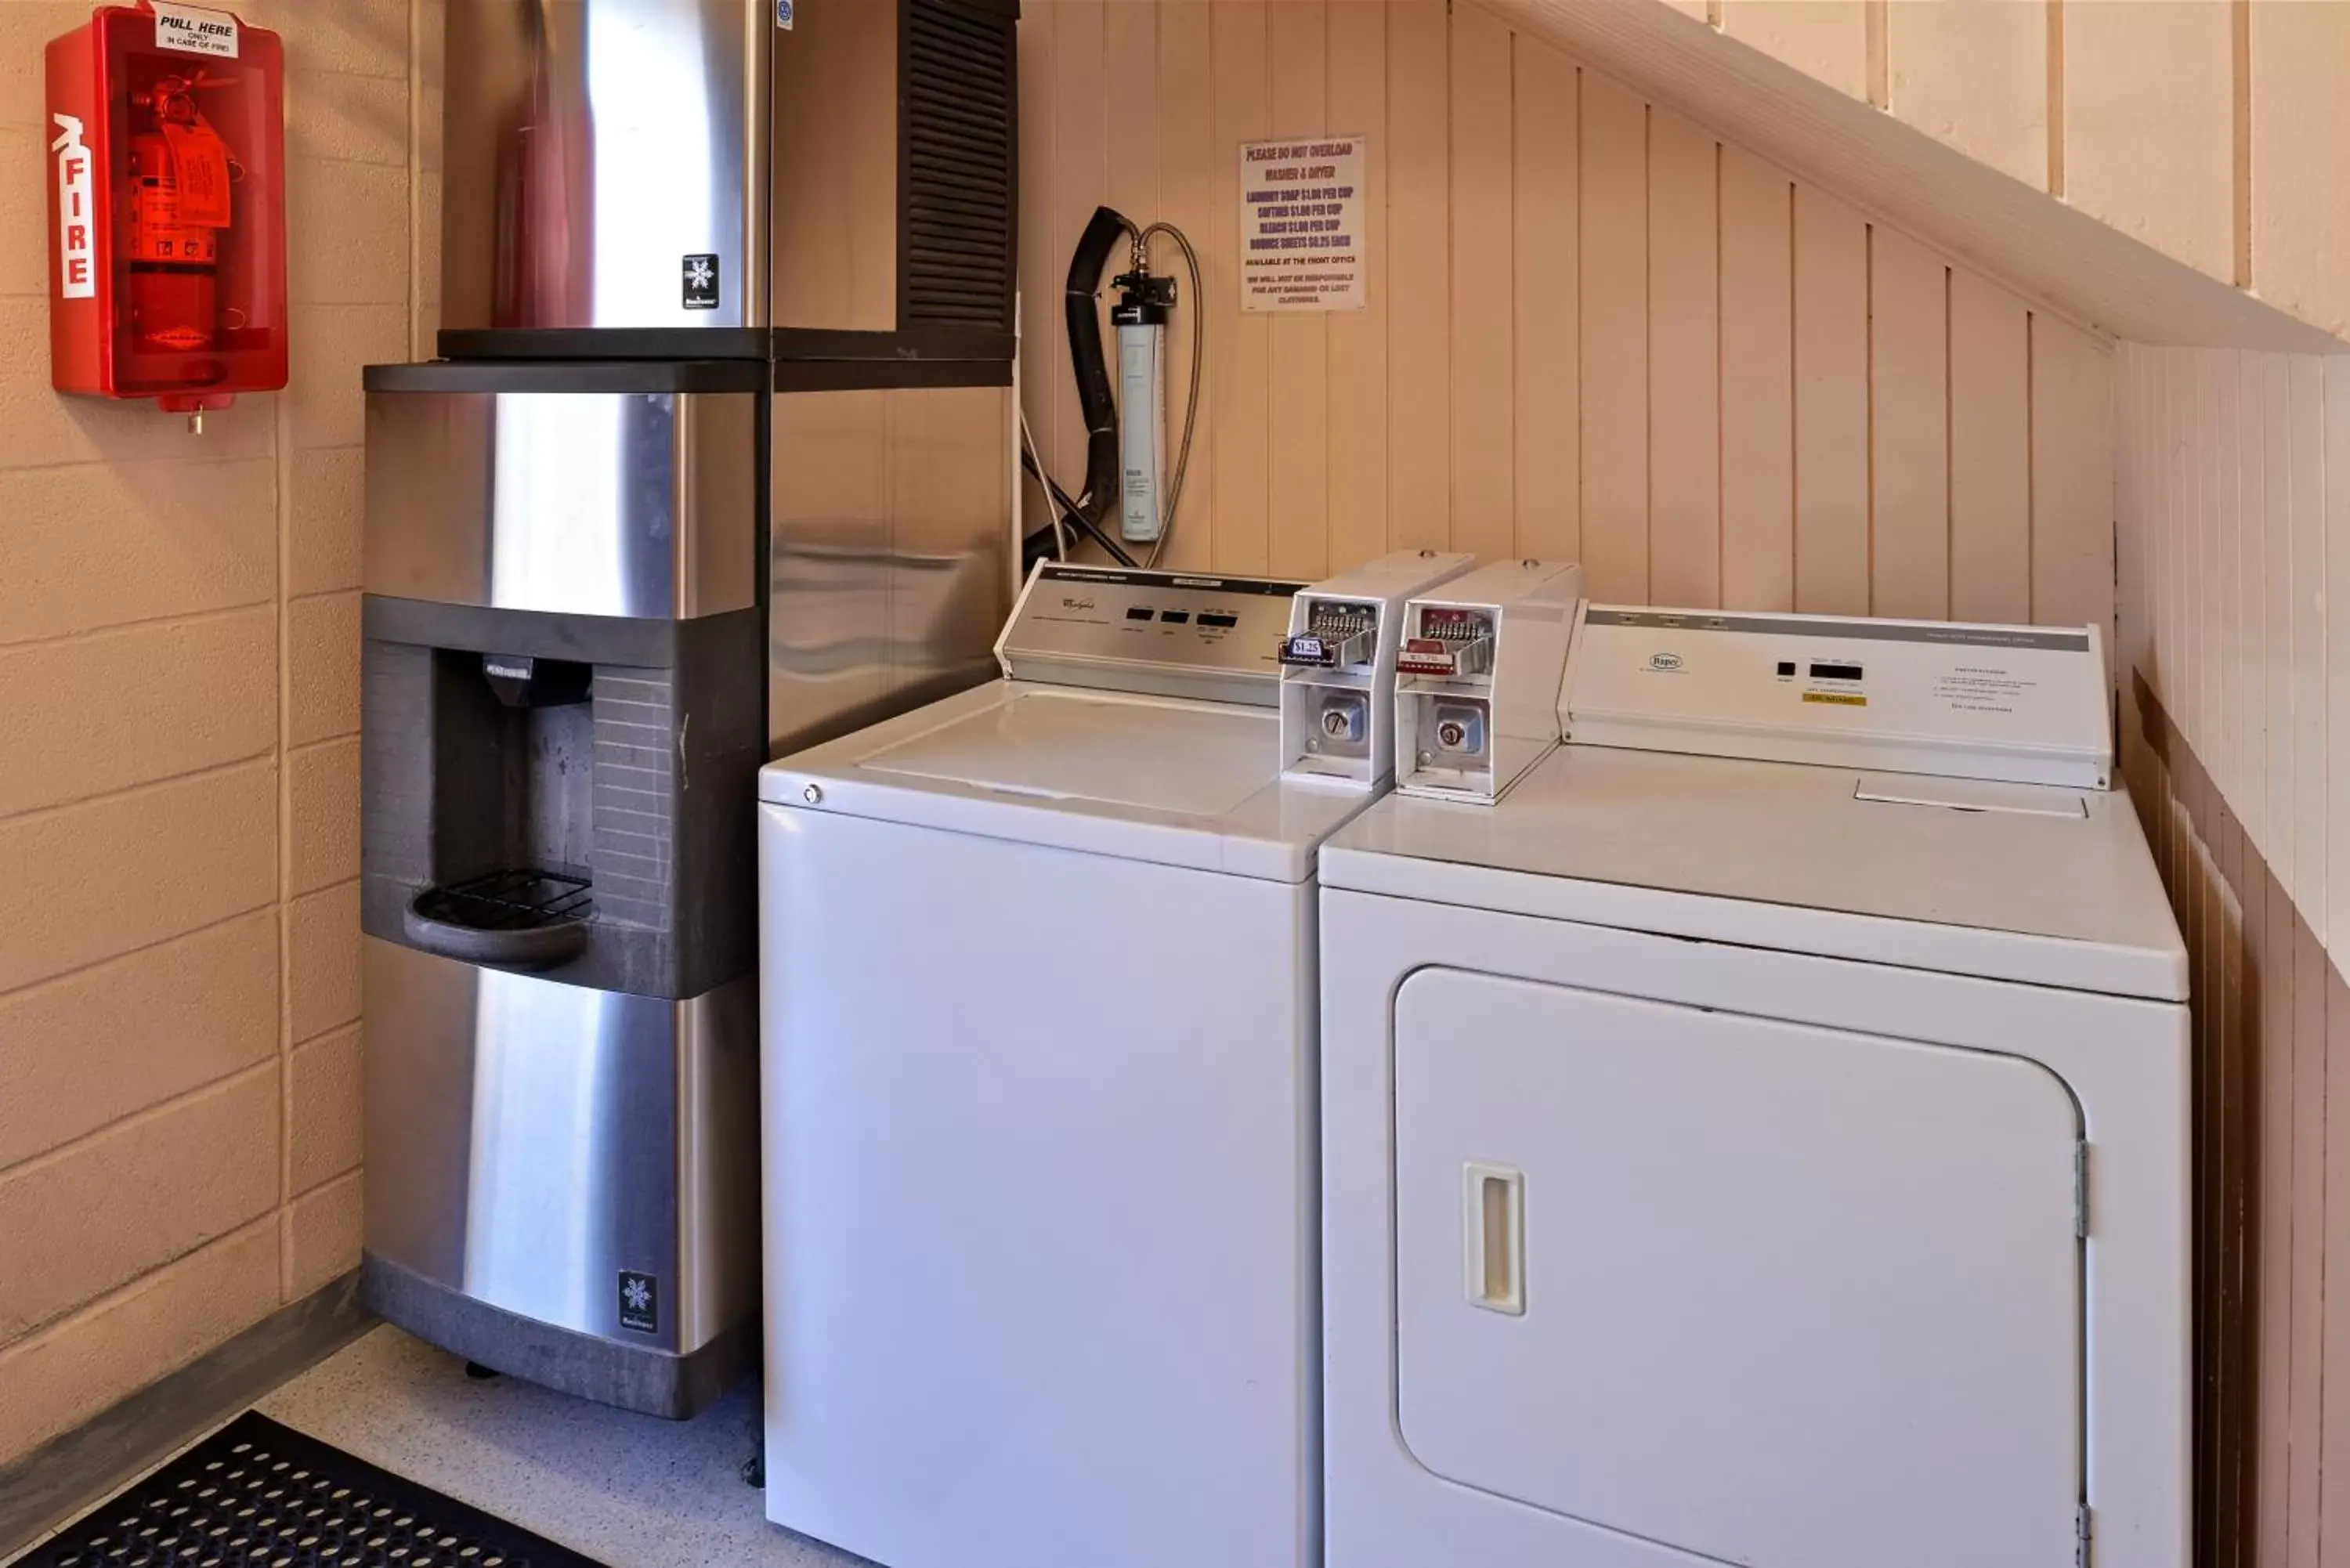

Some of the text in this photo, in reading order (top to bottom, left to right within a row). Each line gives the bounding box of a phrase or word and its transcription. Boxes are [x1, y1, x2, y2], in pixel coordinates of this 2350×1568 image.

[161, 16, 233, 37] PULL HERE
[188, 32, 208, 41] ONLY
[177, 38, 196, 47] CASE
[1246, 143, 1353, 161] PLEASE DO NOT OVERLOAD
[1266, 168, 1298, 182] WASHER
[1308, 165, 1336, 179] DRYER
[1247, 190, 1278, 203] LAUNDRY
[1281, 189, 1300, 201] SOAP
[1322, 187, 1336, 199] PER
[1338, 186, 1354, 198] CUP
[1312, 204, 1325, 215] PER
[1327, 204, 1343, 215] CUP
[66, 158, 87, 284] FIRE
[1310, 220, 1324, 231] PER
[1325, 219, 1340, 230] CUP
[1246, 258, 1281, 266] AVAILABLE
[1305, 273, 1354, 282] RESPONSIBLE
[1295, 641, 1318, 652] $1.25
